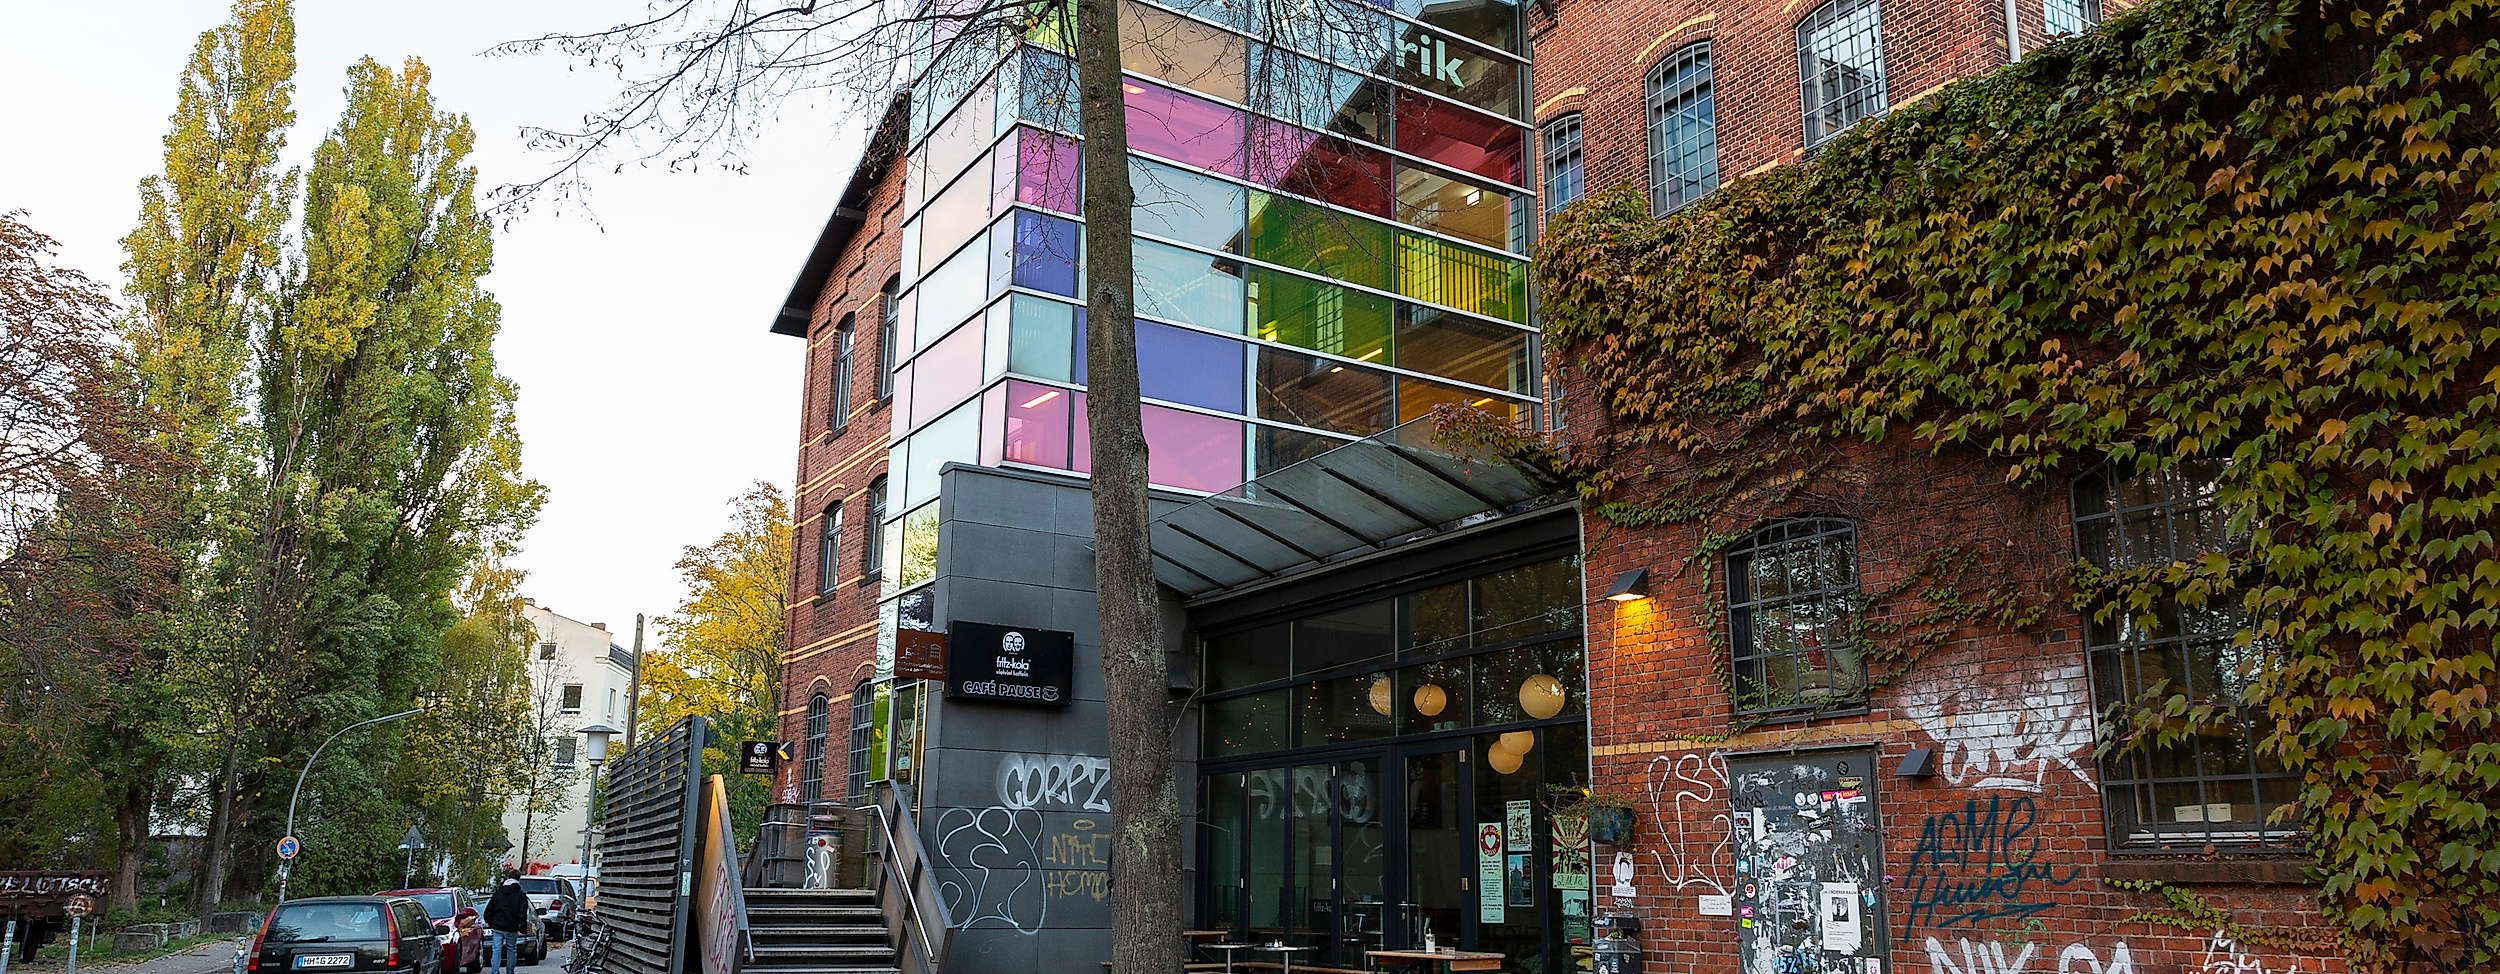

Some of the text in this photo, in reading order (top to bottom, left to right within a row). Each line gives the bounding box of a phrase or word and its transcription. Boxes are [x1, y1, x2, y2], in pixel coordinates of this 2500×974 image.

[1395, 33, 1466, 88] rik
[962, 680, 1041, 699] CAFÉ PAUSE
[303, 956, 349, 966] HH G 2272
